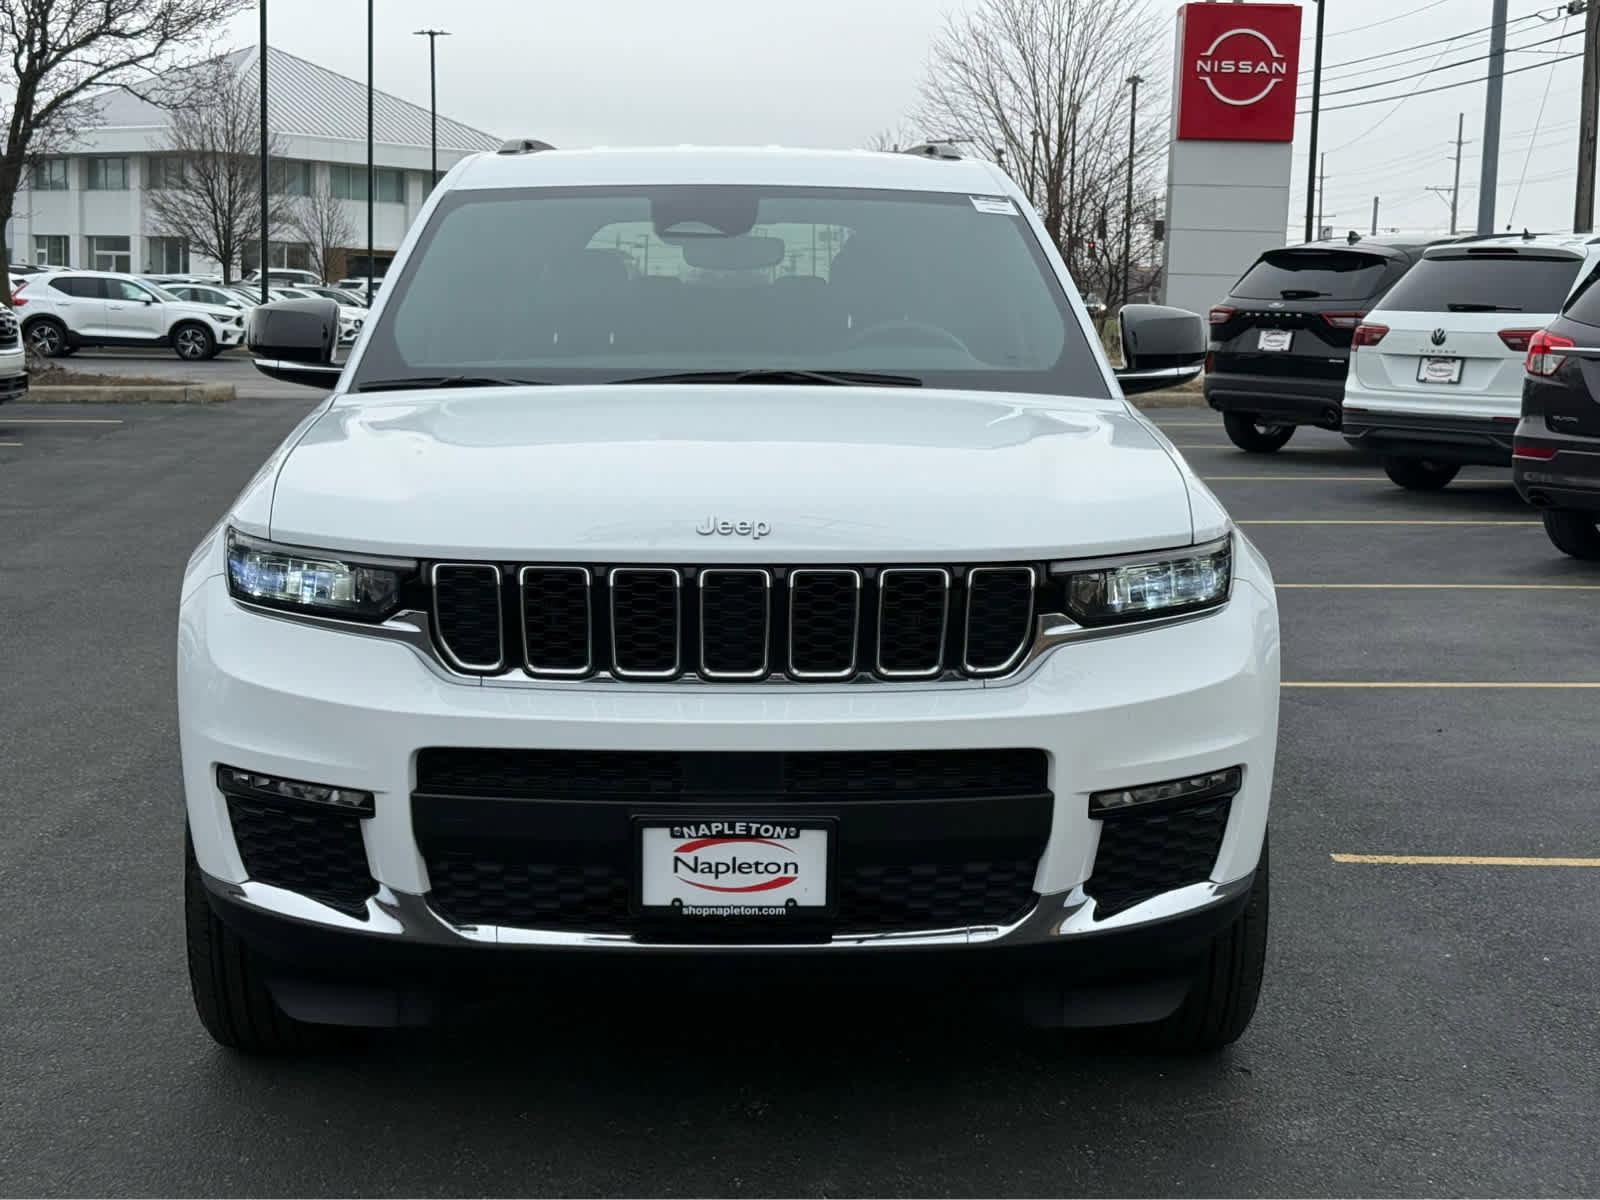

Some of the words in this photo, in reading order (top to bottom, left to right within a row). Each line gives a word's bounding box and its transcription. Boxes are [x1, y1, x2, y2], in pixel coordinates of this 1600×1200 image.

[1196, 60, 1287, 74] NISSAN
[696, 513, 772, 540] Jeep
[682, 822, 787, 839] NAPLETON
[673, 855, 799, 880] Napleton
[682, 904, 786, 917] shopnapleton.com
